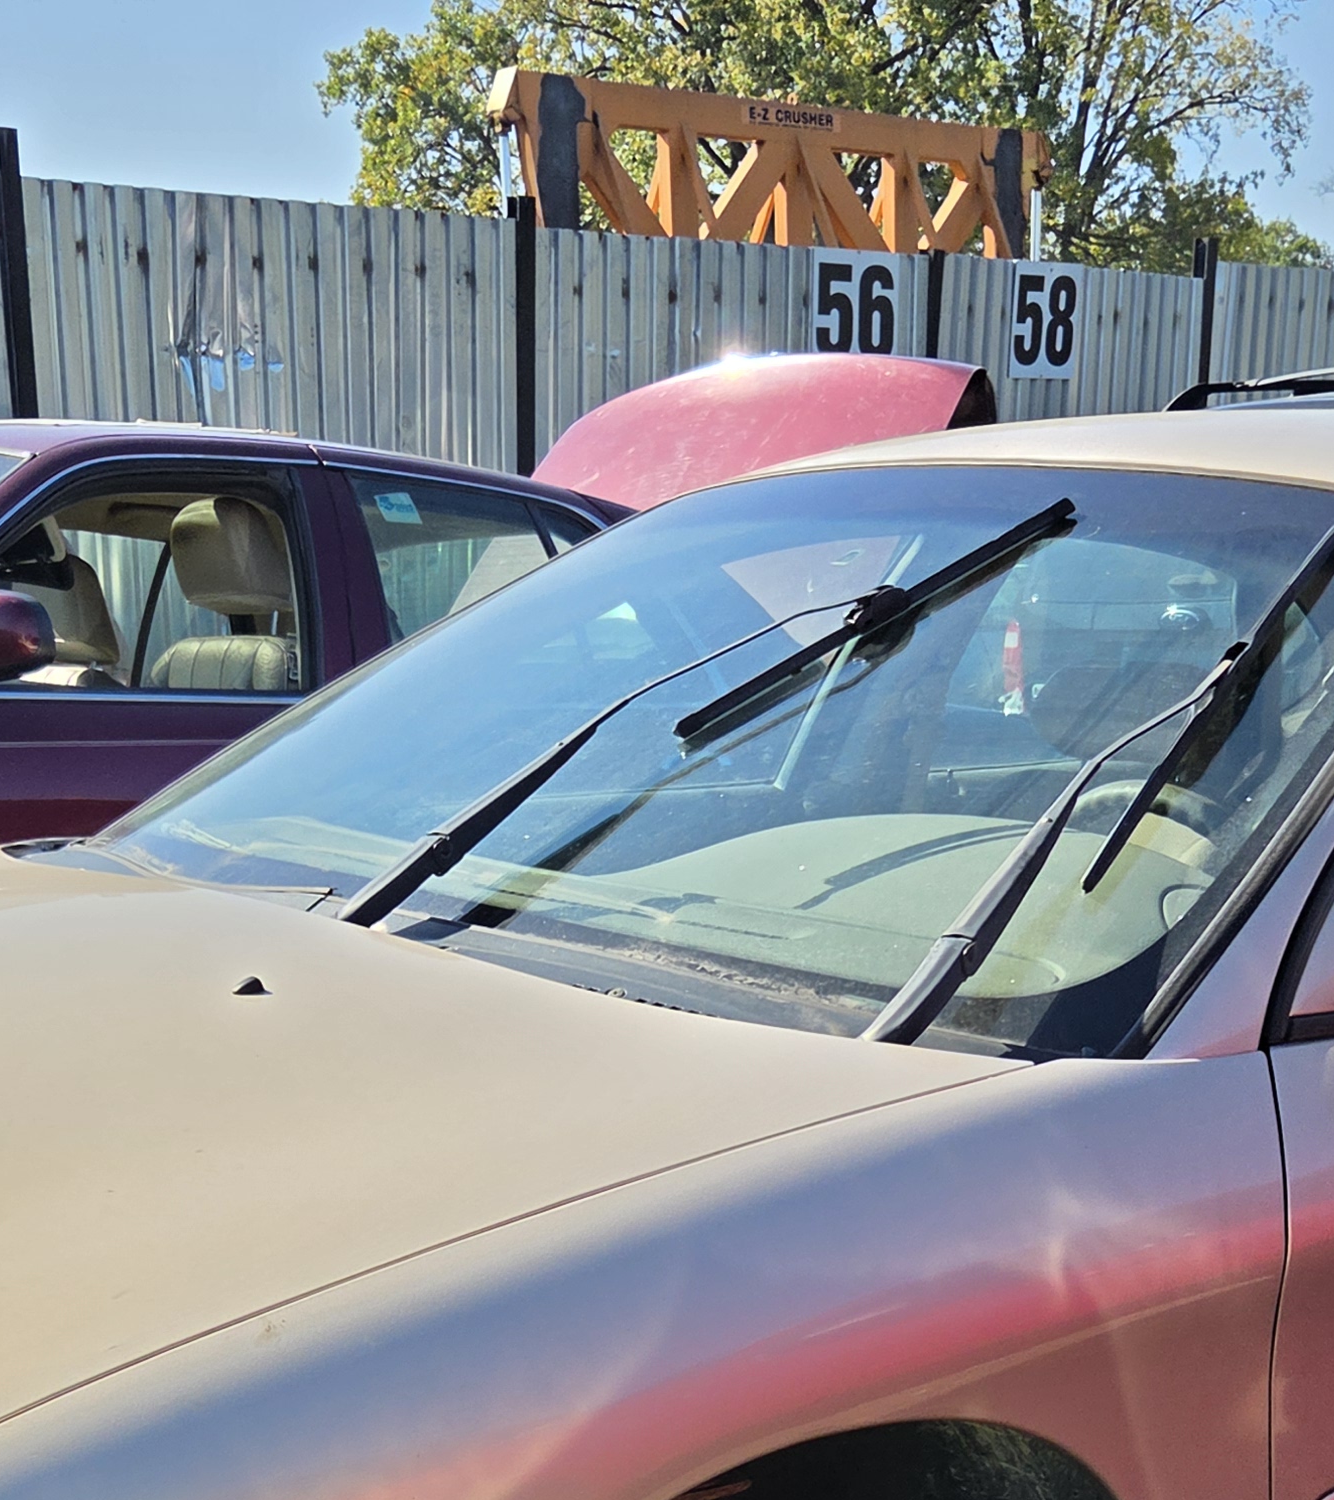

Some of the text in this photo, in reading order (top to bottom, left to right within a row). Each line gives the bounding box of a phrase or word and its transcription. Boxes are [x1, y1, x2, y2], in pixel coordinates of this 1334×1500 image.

[749, 106, 769, 121] E-Z
[775, 108, 834, 127] CRUSHER
[815, 262, 895, 354] 56
[1013, 273, 1077, 367] 58
